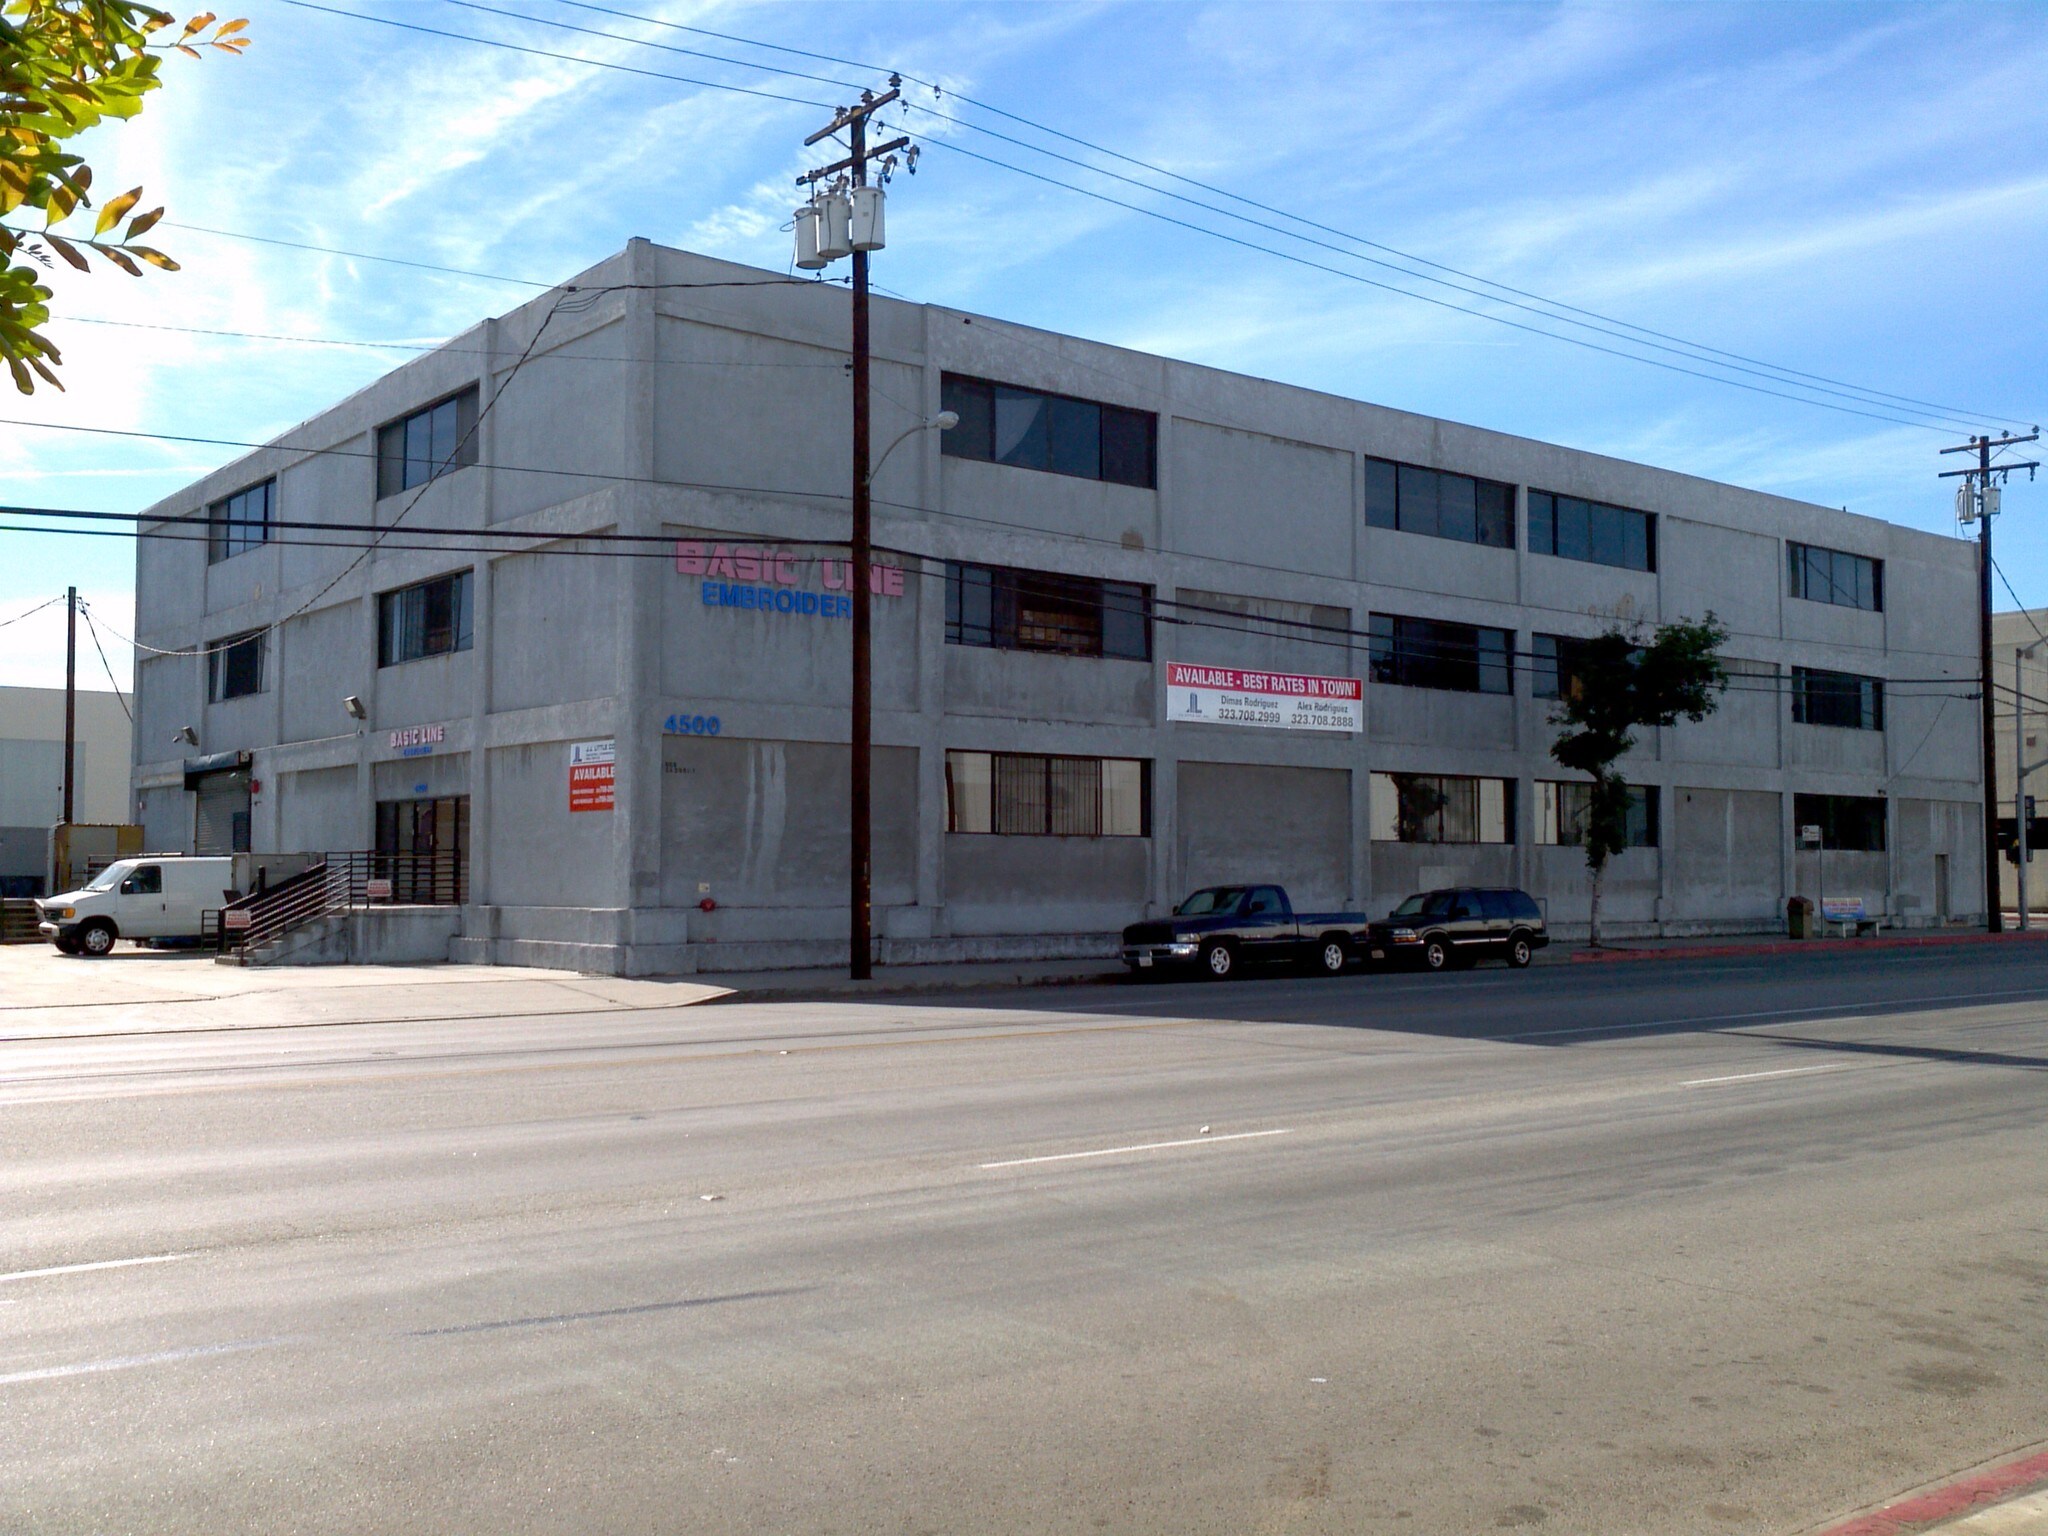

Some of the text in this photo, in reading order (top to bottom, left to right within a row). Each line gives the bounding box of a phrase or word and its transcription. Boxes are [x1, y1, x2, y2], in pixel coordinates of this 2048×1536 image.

[676, 541, 905, 597] BASIC LINE
[1175, 667, 1234, 688] AVAILABLE
[1243, 674, 1268, 690] BEST
[1271, 677, 1305, 694] RATES
[1307, 680, 1319, 695] IN
[1321, 681, 1356, 697] TOWN!
[1244, 696, 1279, 710] Rodriguez
[1297, 701, 1349, 714] Alex Rodriguez
[664, 713, 721, 736] 4500
[1218, 708, 1281, 724] 323.708.2999
[389, 724, 446, 749] BASIC LINE
[573, 766, 615, 782] AVAILABLE
